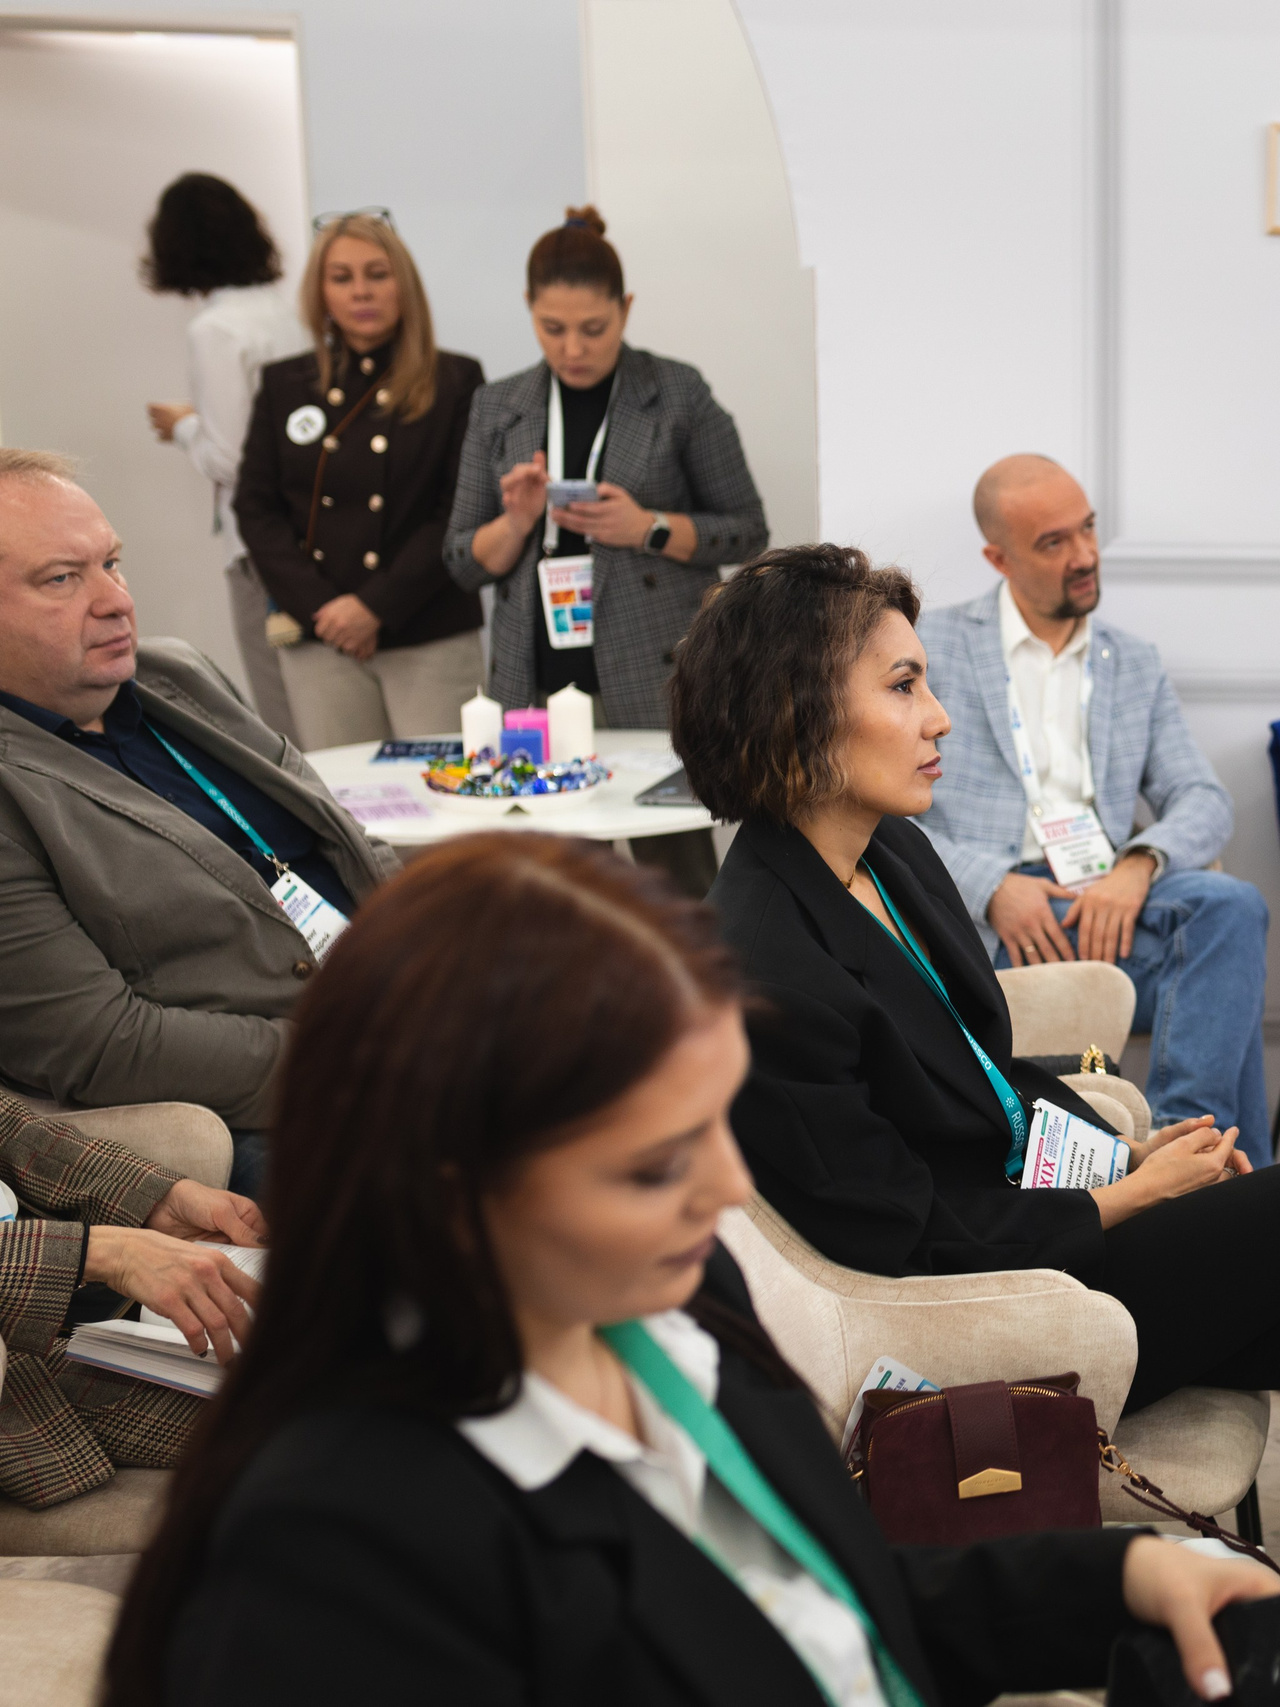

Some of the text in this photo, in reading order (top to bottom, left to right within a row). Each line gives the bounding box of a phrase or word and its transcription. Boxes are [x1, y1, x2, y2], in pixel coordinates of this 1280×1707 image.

[963, 1028, 992, 1071] RUSSCO
[1038, 1157, 1056, 1188] XIX
[1074, 1153, 1086, 1189] атьяна
[1083, 1147, 1096, 1190] ерьевна
